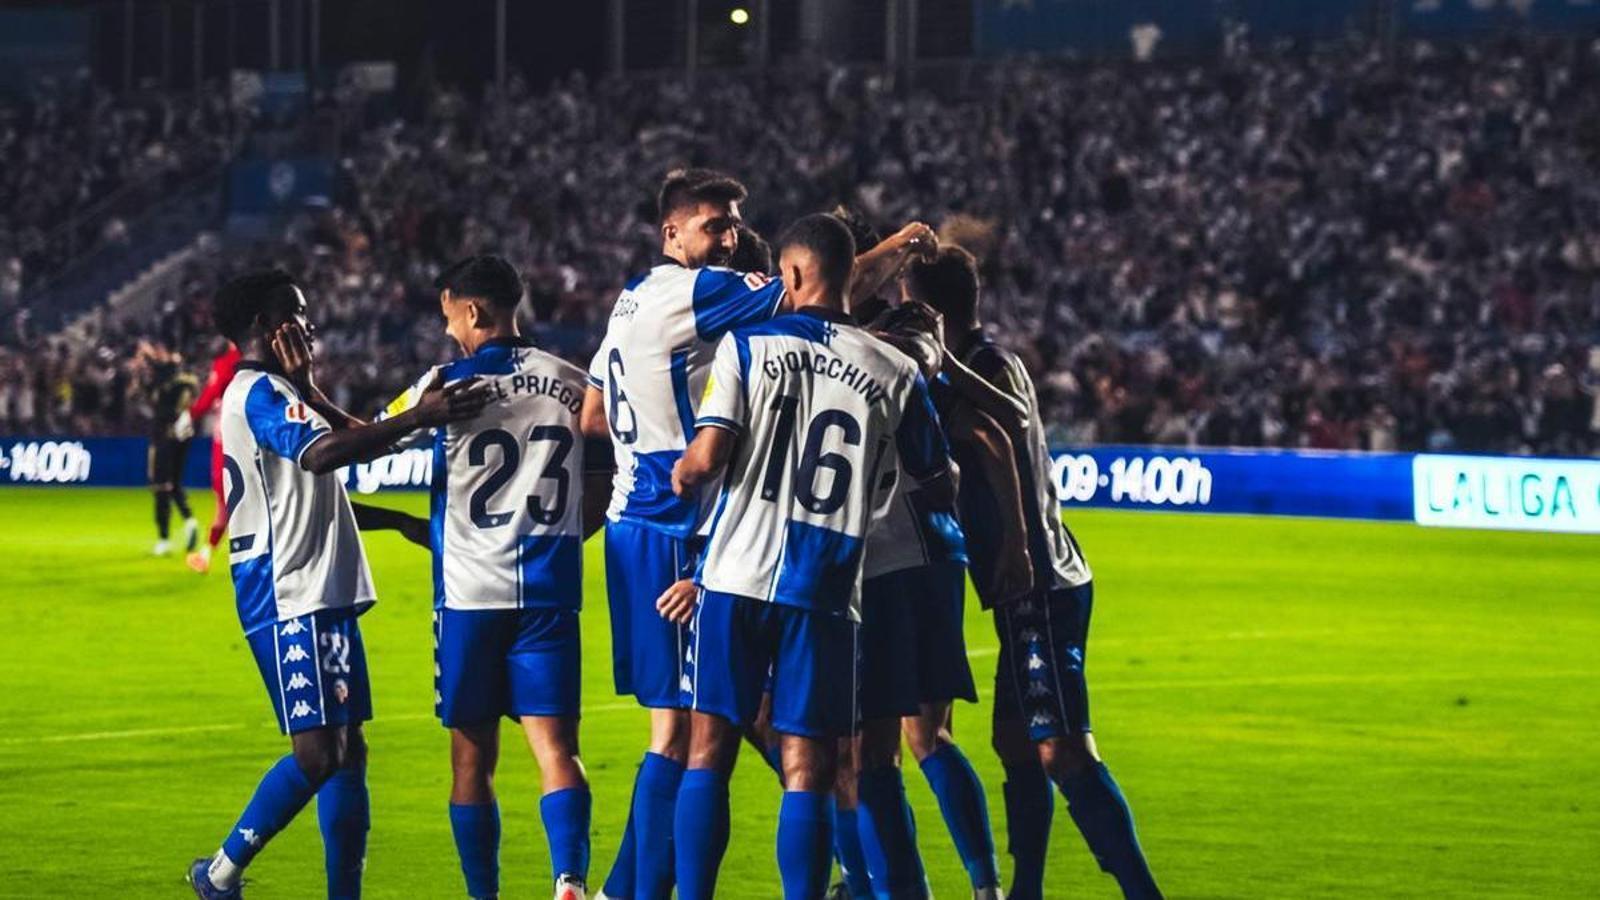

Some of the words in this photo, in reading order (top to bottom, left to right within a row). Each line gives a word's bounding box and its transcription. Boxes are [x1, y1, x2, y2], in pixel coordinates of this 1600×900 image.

[512, 375, 584, 415] PRIEGO
[608, 347, 638, 445] 6
[468, 424, 574, 530] 23
[760, 394, 862, 515] 16
[1427, 471, 1576, 518] LALIGA
